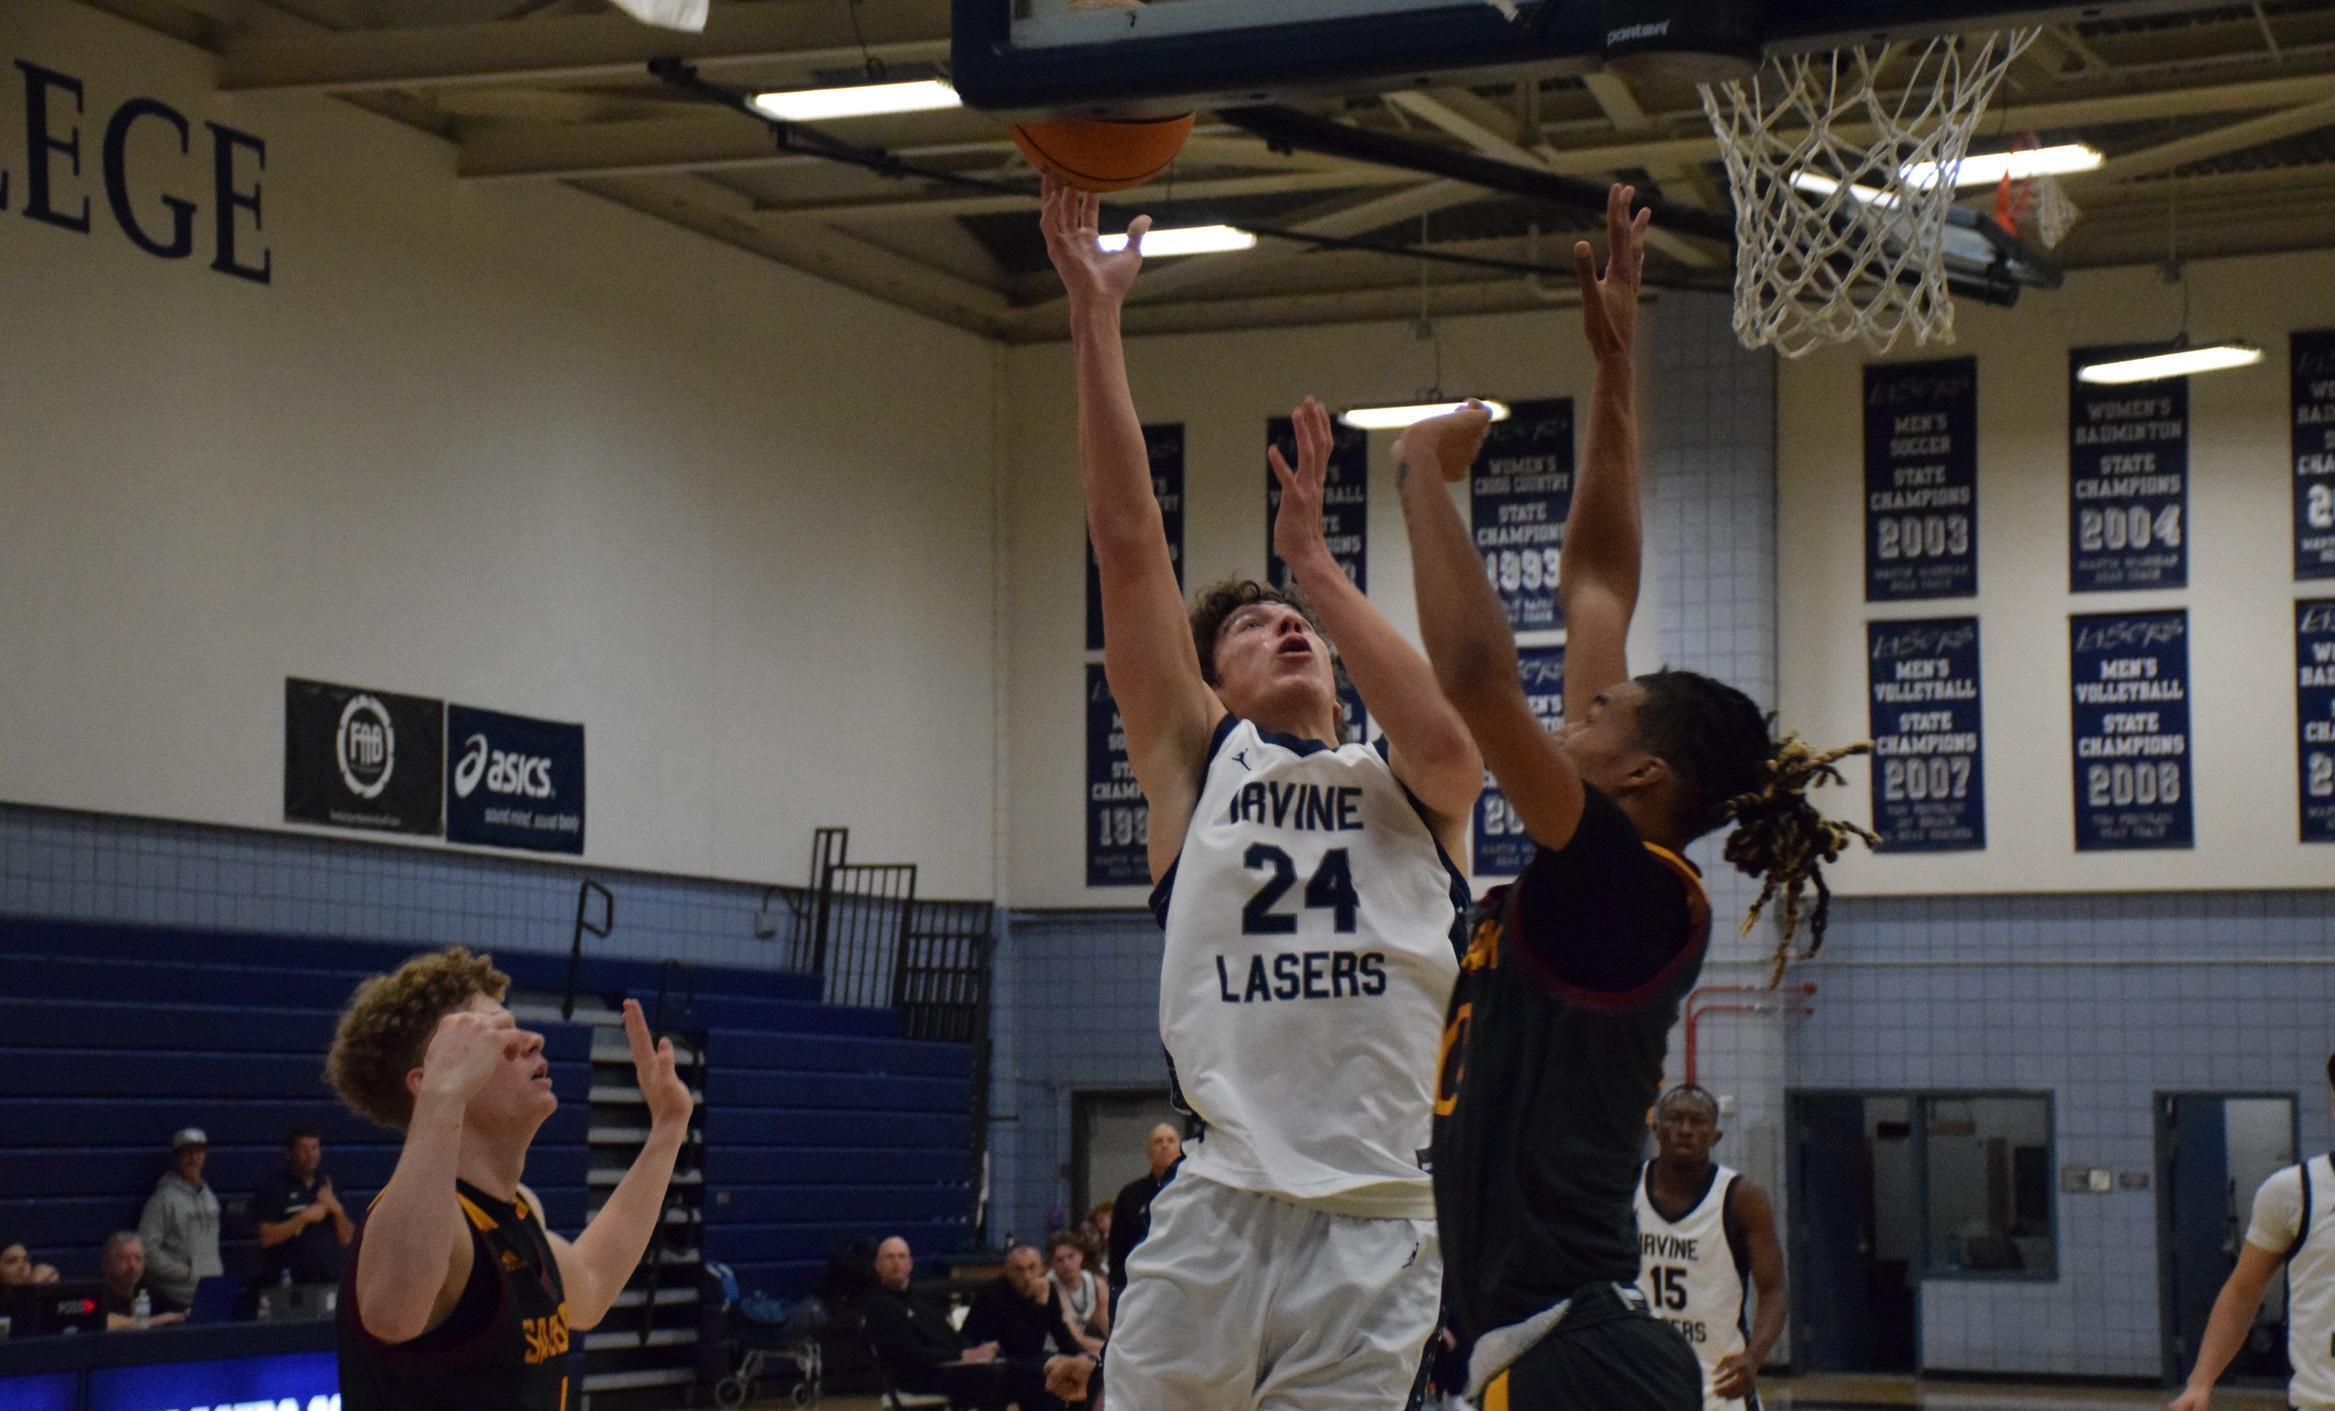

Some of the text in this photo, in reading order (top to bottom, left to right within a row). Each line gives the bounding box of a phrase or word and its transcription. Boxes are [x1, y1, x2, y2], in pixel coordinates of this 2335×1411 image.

[0, 58, 271, 285] EGE
[1895, 412, 1949, 434] MEN'S
[2075, 418, 2183, 445] BADMINTON
[2100, 452, 2156, 475] STATE
[1894, 465, 1947, 487] STATE
[2076, 474, 2182, 500] CHAMPIONS
[1871, 486, 1971, 512] CHAMPIONS
[1499, 501, 1547, 523] STATE
[1477, 522, 1567, 546] CHAMPION
[1878, 515, 1969, 560] 2003
[2080, 503, 2181, 552] 2004
[1896, 658, 1950, 680] MEN'S
[2101, 657, 2158, 680] MEN'S
[1875, 678, 1977, 702] VOLLEYBALL
[2076, 679, 2184, 703] VOLLEYBALL
[1900, 710, 1953, 732] STATE
[2103, 712, 2160, 734] STATE
[1876, 732, 1977, 756] CHAMPIONS
[2078, 734, 2185, 758] CHAMPIONS
[1884, 756, 1971, 802] 2007
[1230, 781, 1364, 832] IRVINE
[1241, 841, 1361, 936] 24
[1216, 951, 1387, 1003] LASERS
[1639, 1233, 1699, 1261] IRVINE
[1650, 1264, 1688, 1311] 15
